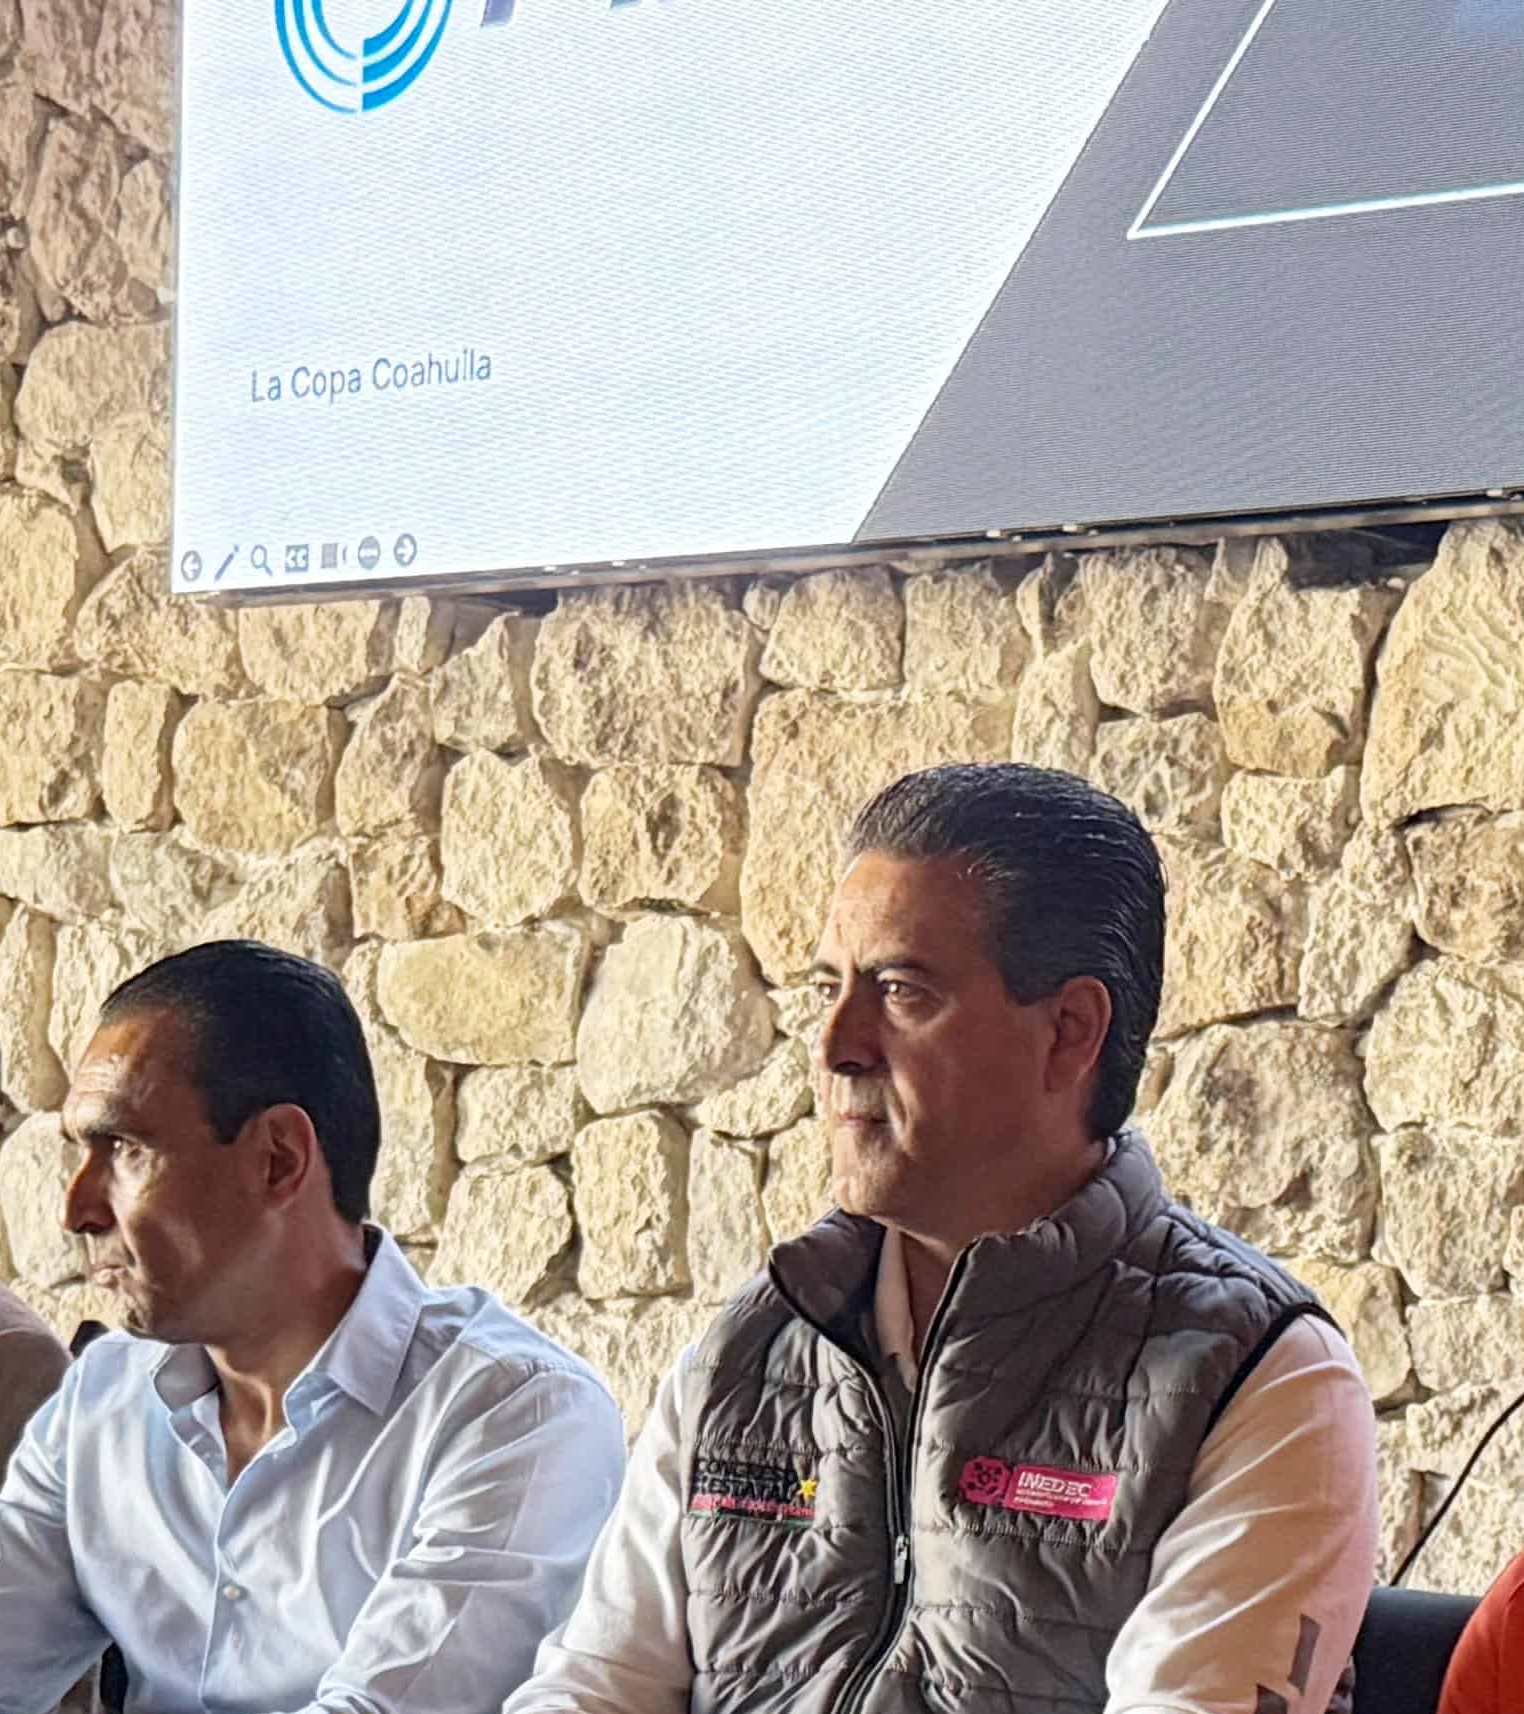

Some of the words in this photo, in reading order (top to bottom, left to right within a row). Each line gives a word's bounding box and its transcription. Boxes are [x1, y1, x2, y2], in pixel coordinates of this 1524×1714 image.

[251, 369, 282, 402] La
[291, 365, 362, 404] Copa
[372, 348, 492, 390] Coahuila
